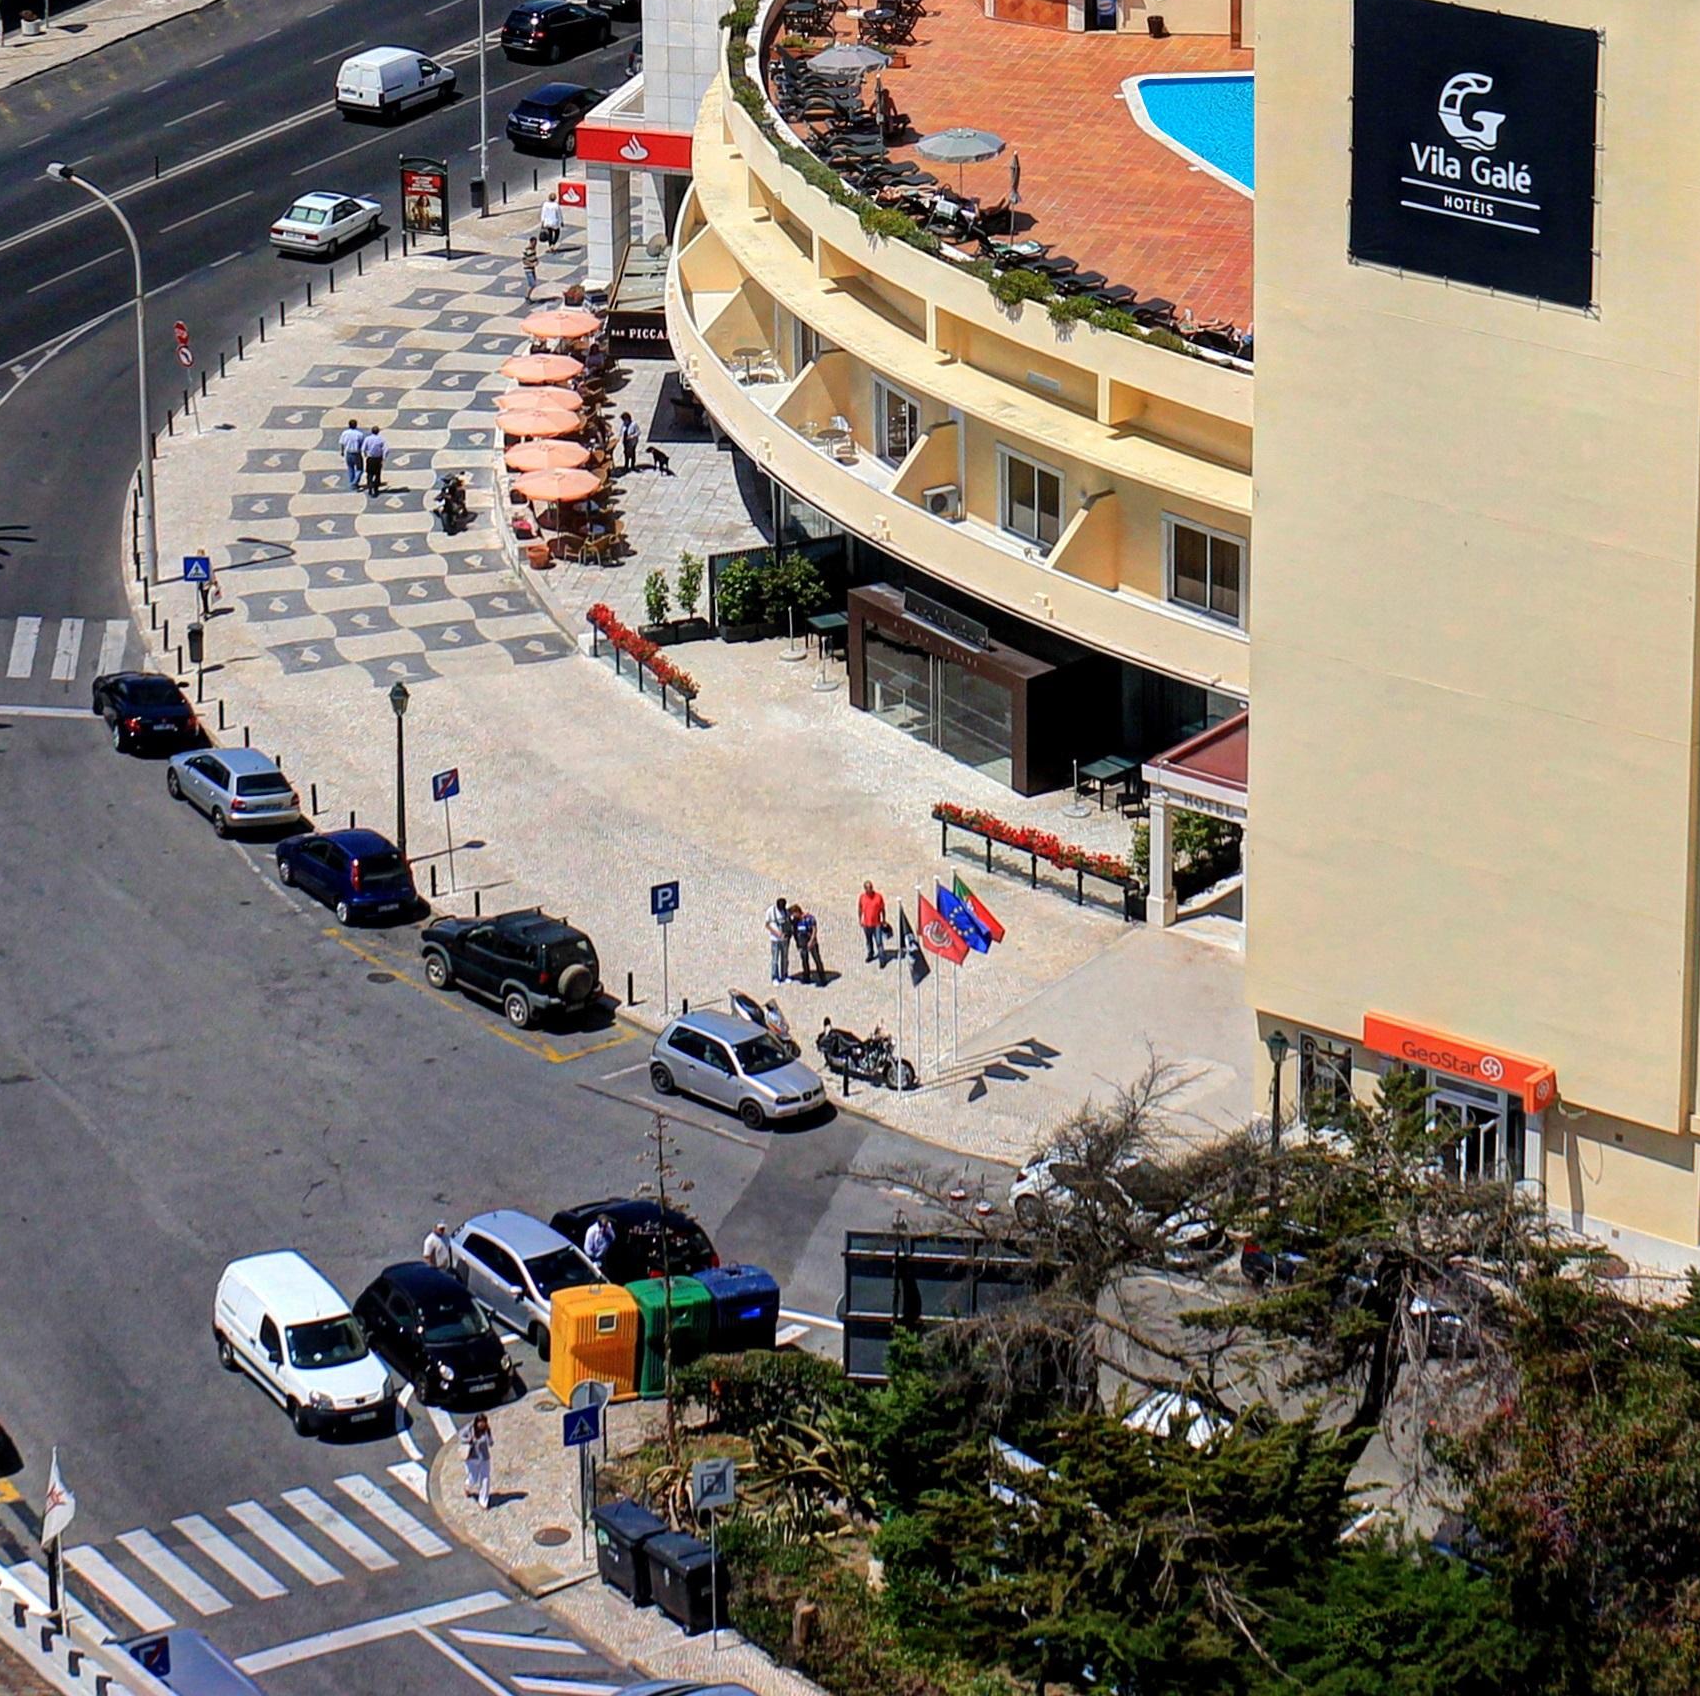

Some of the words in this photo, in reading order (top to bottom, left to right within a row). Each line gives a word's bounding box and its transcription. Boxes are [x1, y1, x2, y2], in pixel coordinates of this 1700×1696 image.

[1411, 142, 1461, 181] Vila
[1470, 155, 1532, 195] Galé
[1443, 194, 1495, 217] HOTÉIS
[629, 328, 670, 340] PICCA
[1183, 793, 1234, 818] HOTEL
[1401, 1041, 1480, 1076] GeoStar
